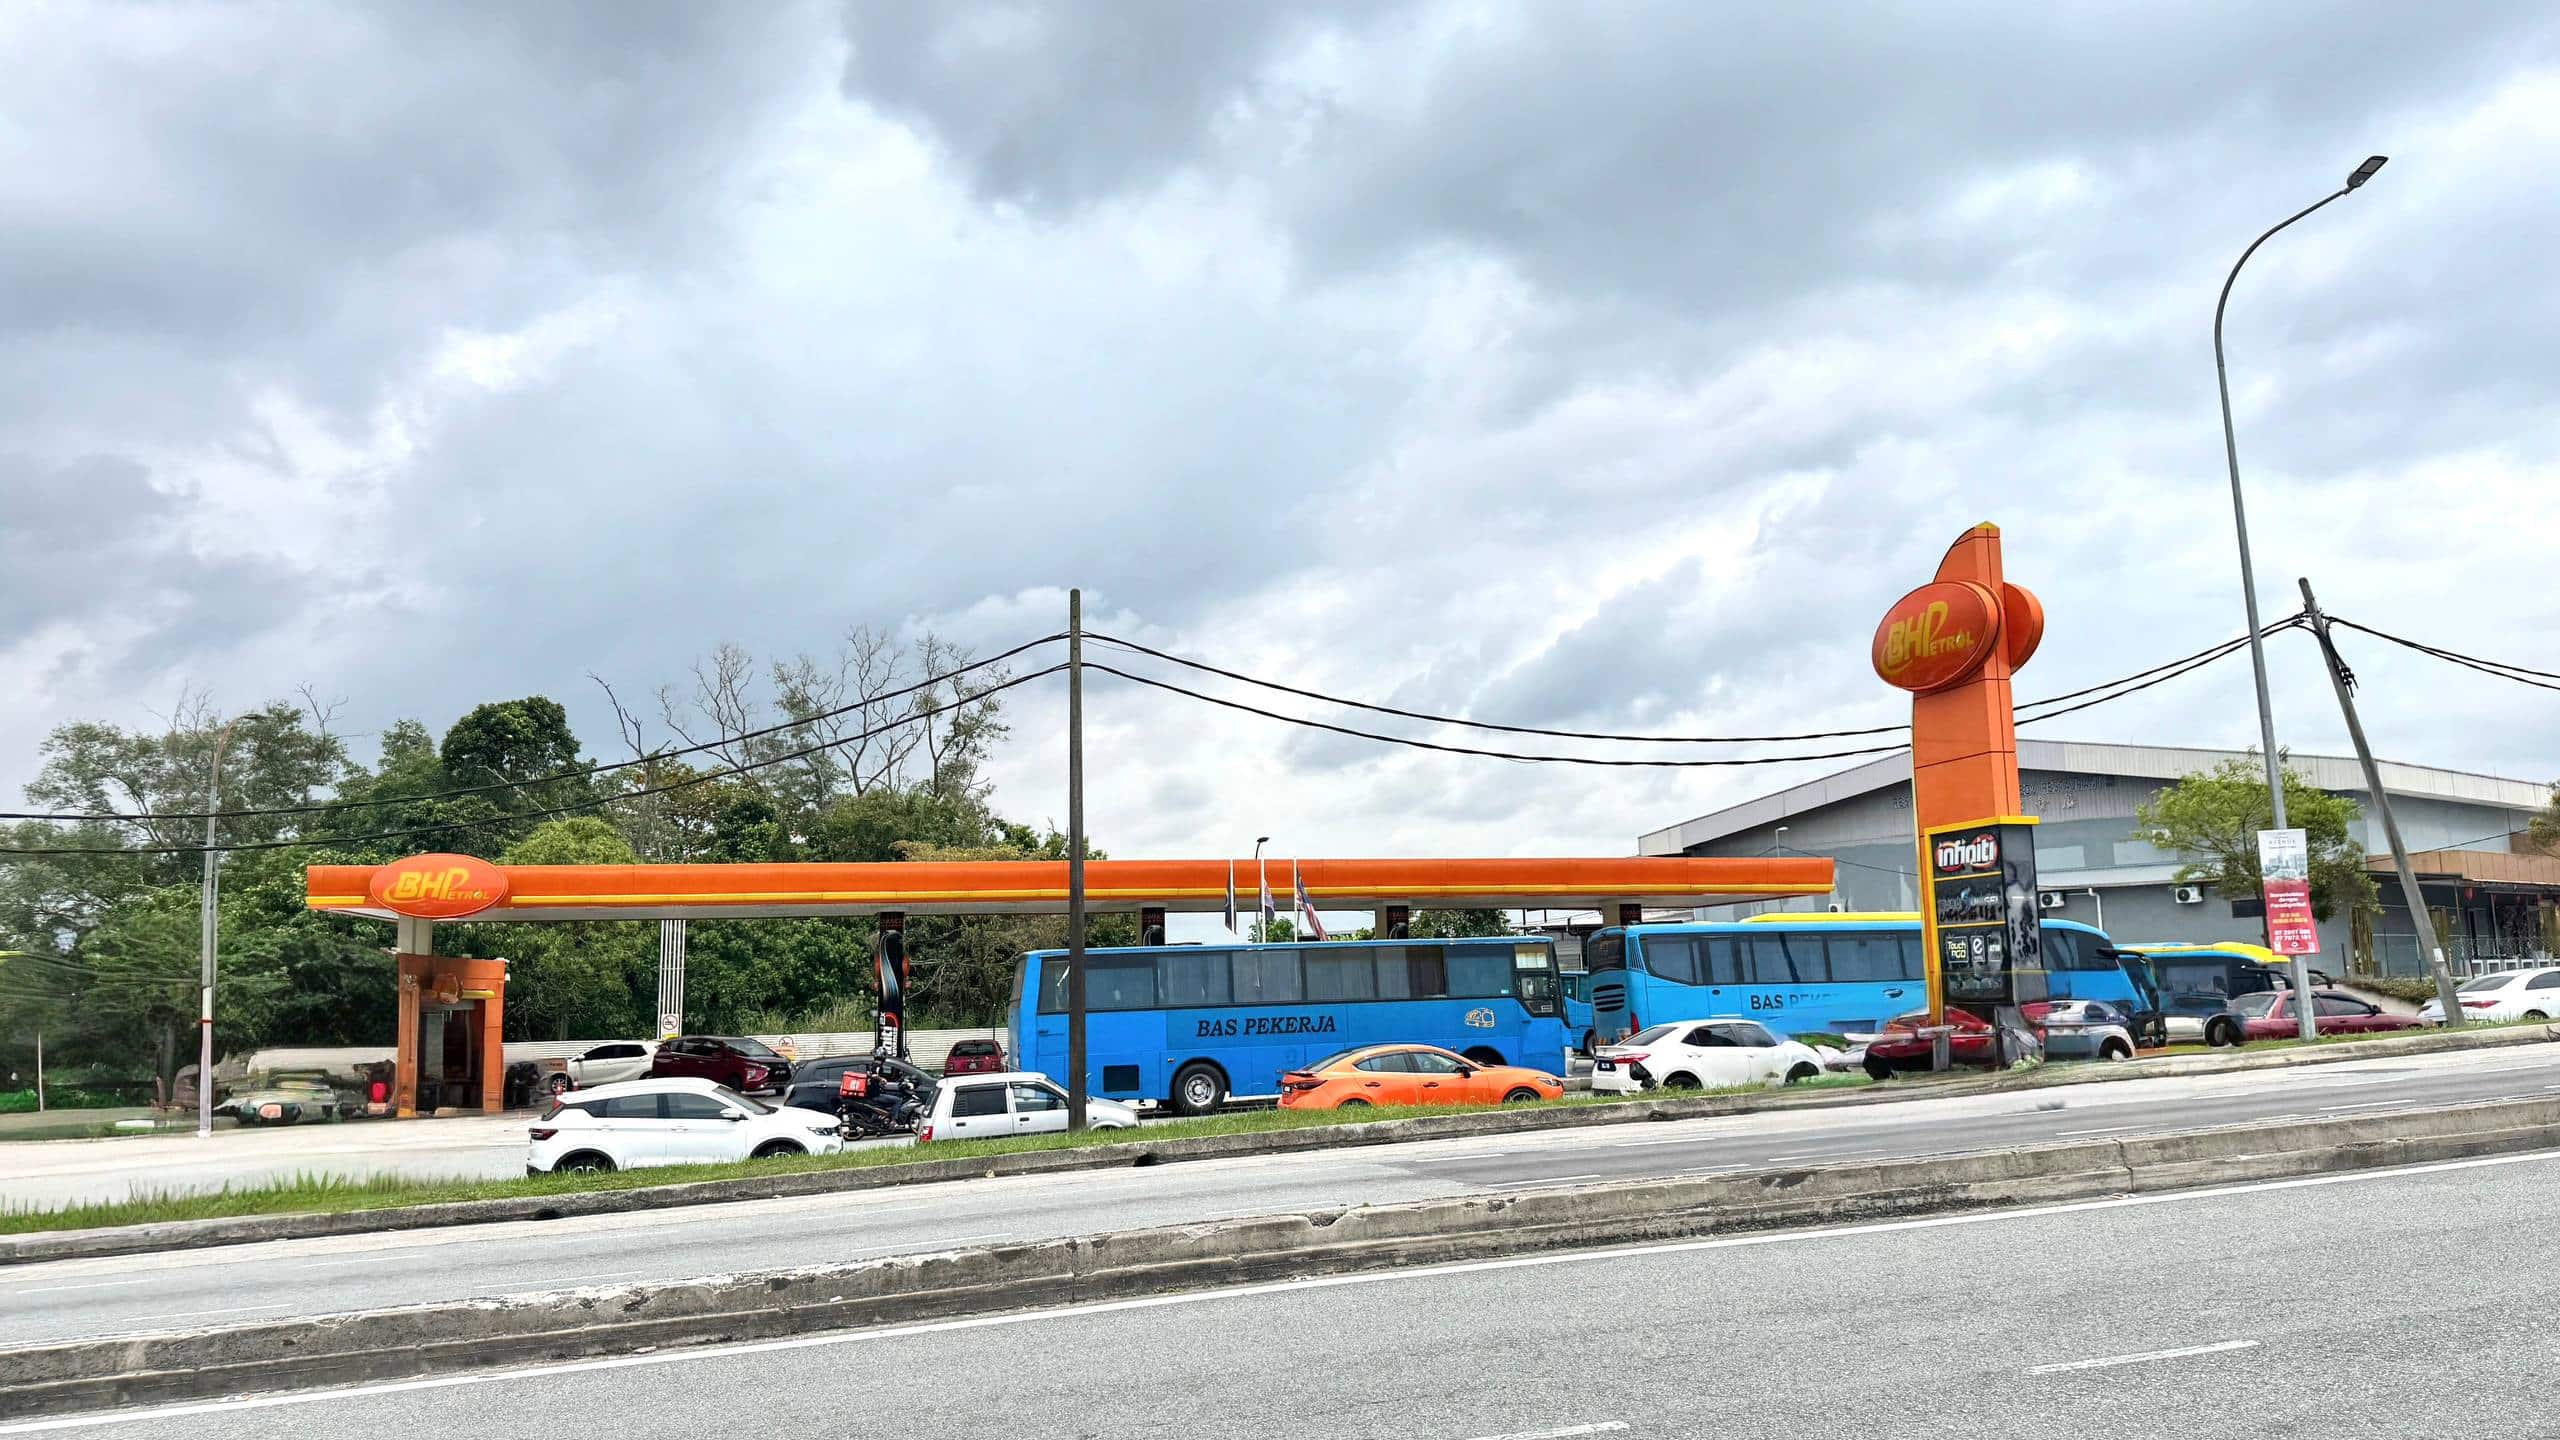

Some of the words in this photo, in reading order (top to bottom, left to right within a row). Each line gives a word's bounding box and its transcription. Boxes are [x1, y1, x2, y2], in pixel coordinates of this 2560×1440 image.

[1936, 839, 1995, 868] infiniti
[1948, 940, 1967, 950] Touch
[1751, 994, 1784, 1010] BAS
[1196, 1018, 1238, 1037] BAS
[1243, 1016, 1336, 1035] PEKERJA
